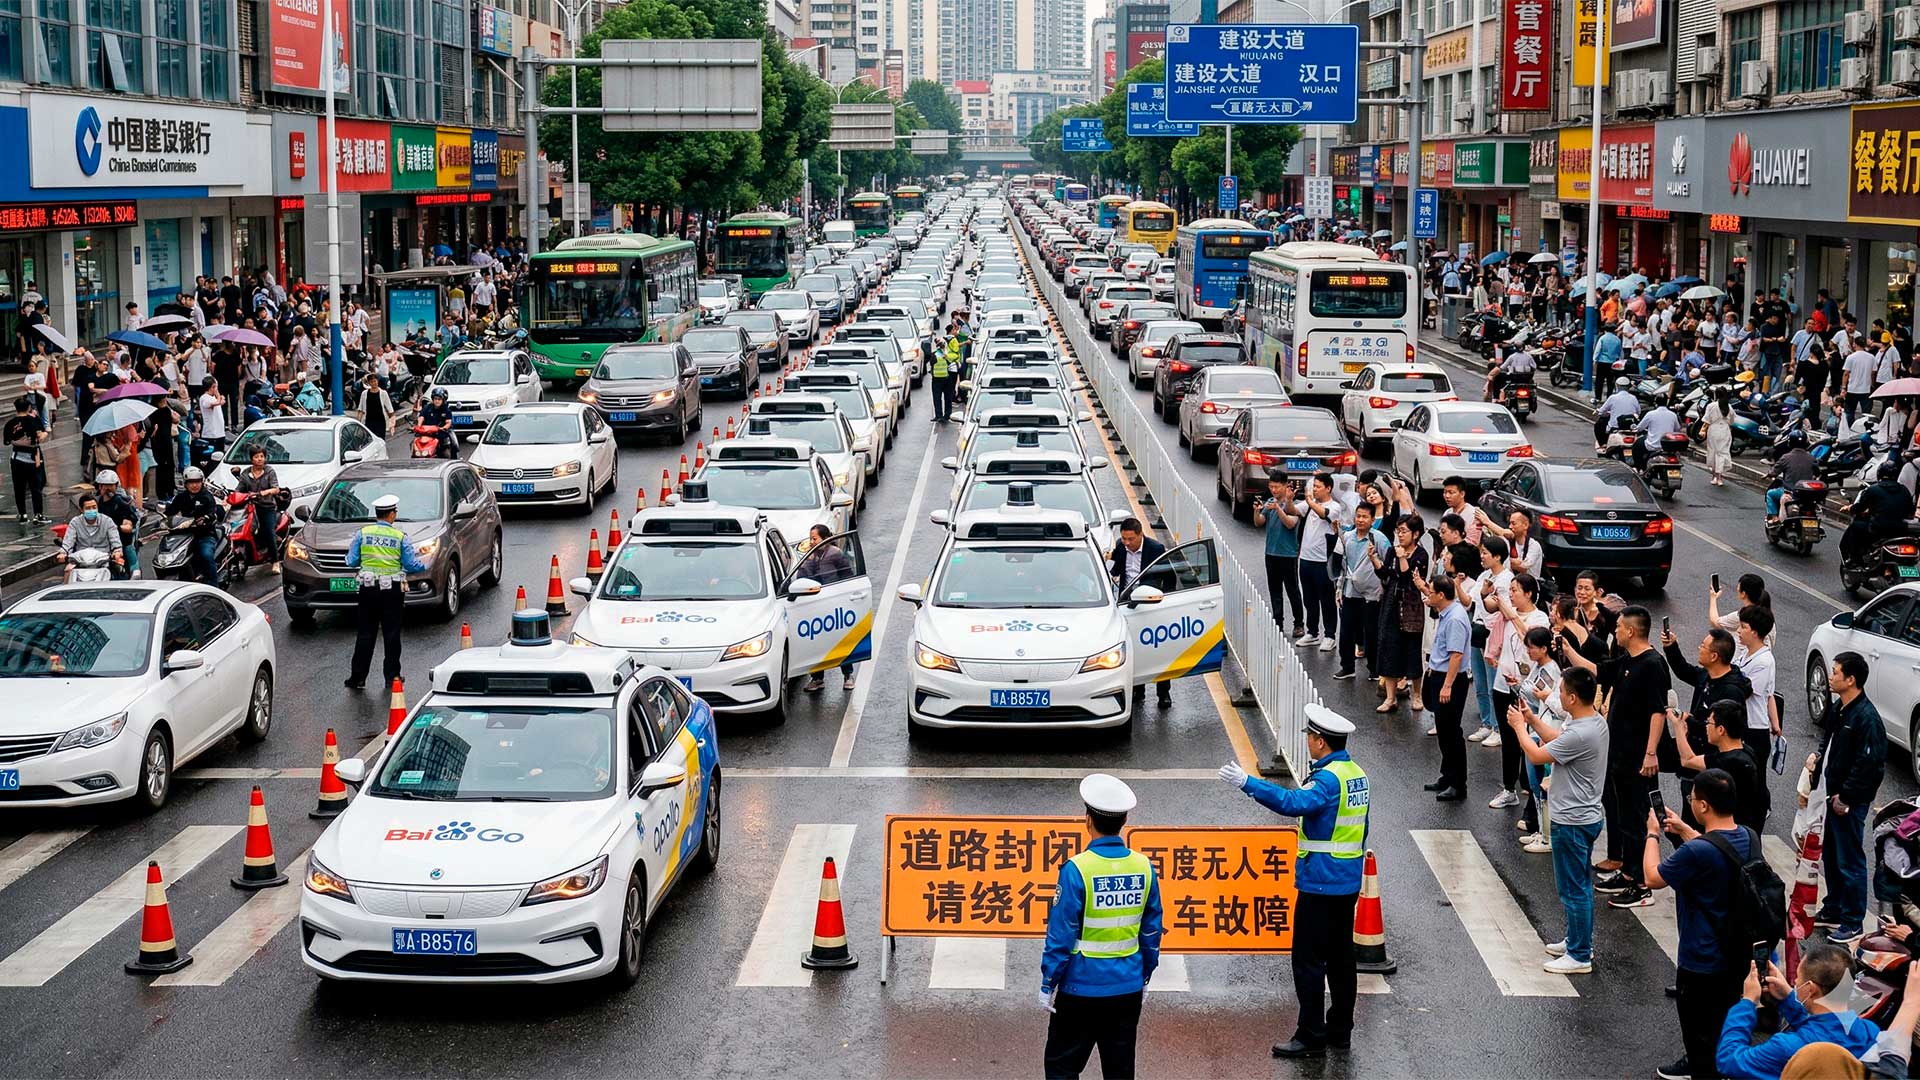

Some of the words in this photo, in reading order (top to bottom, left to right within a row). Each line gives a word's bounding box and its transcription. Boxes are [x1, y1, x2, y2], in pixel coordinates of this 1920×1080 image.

[1219, 29, 1305, 50] 建设大道
[1175, 63, 1262, 83] 建设大道
[1299, 64, 1341, 83] 汉口
[1175, 86, 1215, 94] JIANSHE
[1219, 86, 1259, 94] AVENUE
[1302, 86, 1338, 94] WUHAN
[108, 117, 212, 155] 中国建设银行
[1753, 149, 1811, 186] HUAWEI
[1854, 129, 1920, 194] 餐餐厅
[798, 607, 856, 640] apollo
[1140, 616, 1205, 648] apollo
[477, 828, 525, 843] Go
[900, 828, 1082, 873] 道路封闭
[1141, 845, 1290, 881] 百度无人车
[923, 880, 1052, 924] 请绕行
[1096, 892, 1142, 908] POLICE
[1163, 895, 1290, 936] 车故障
